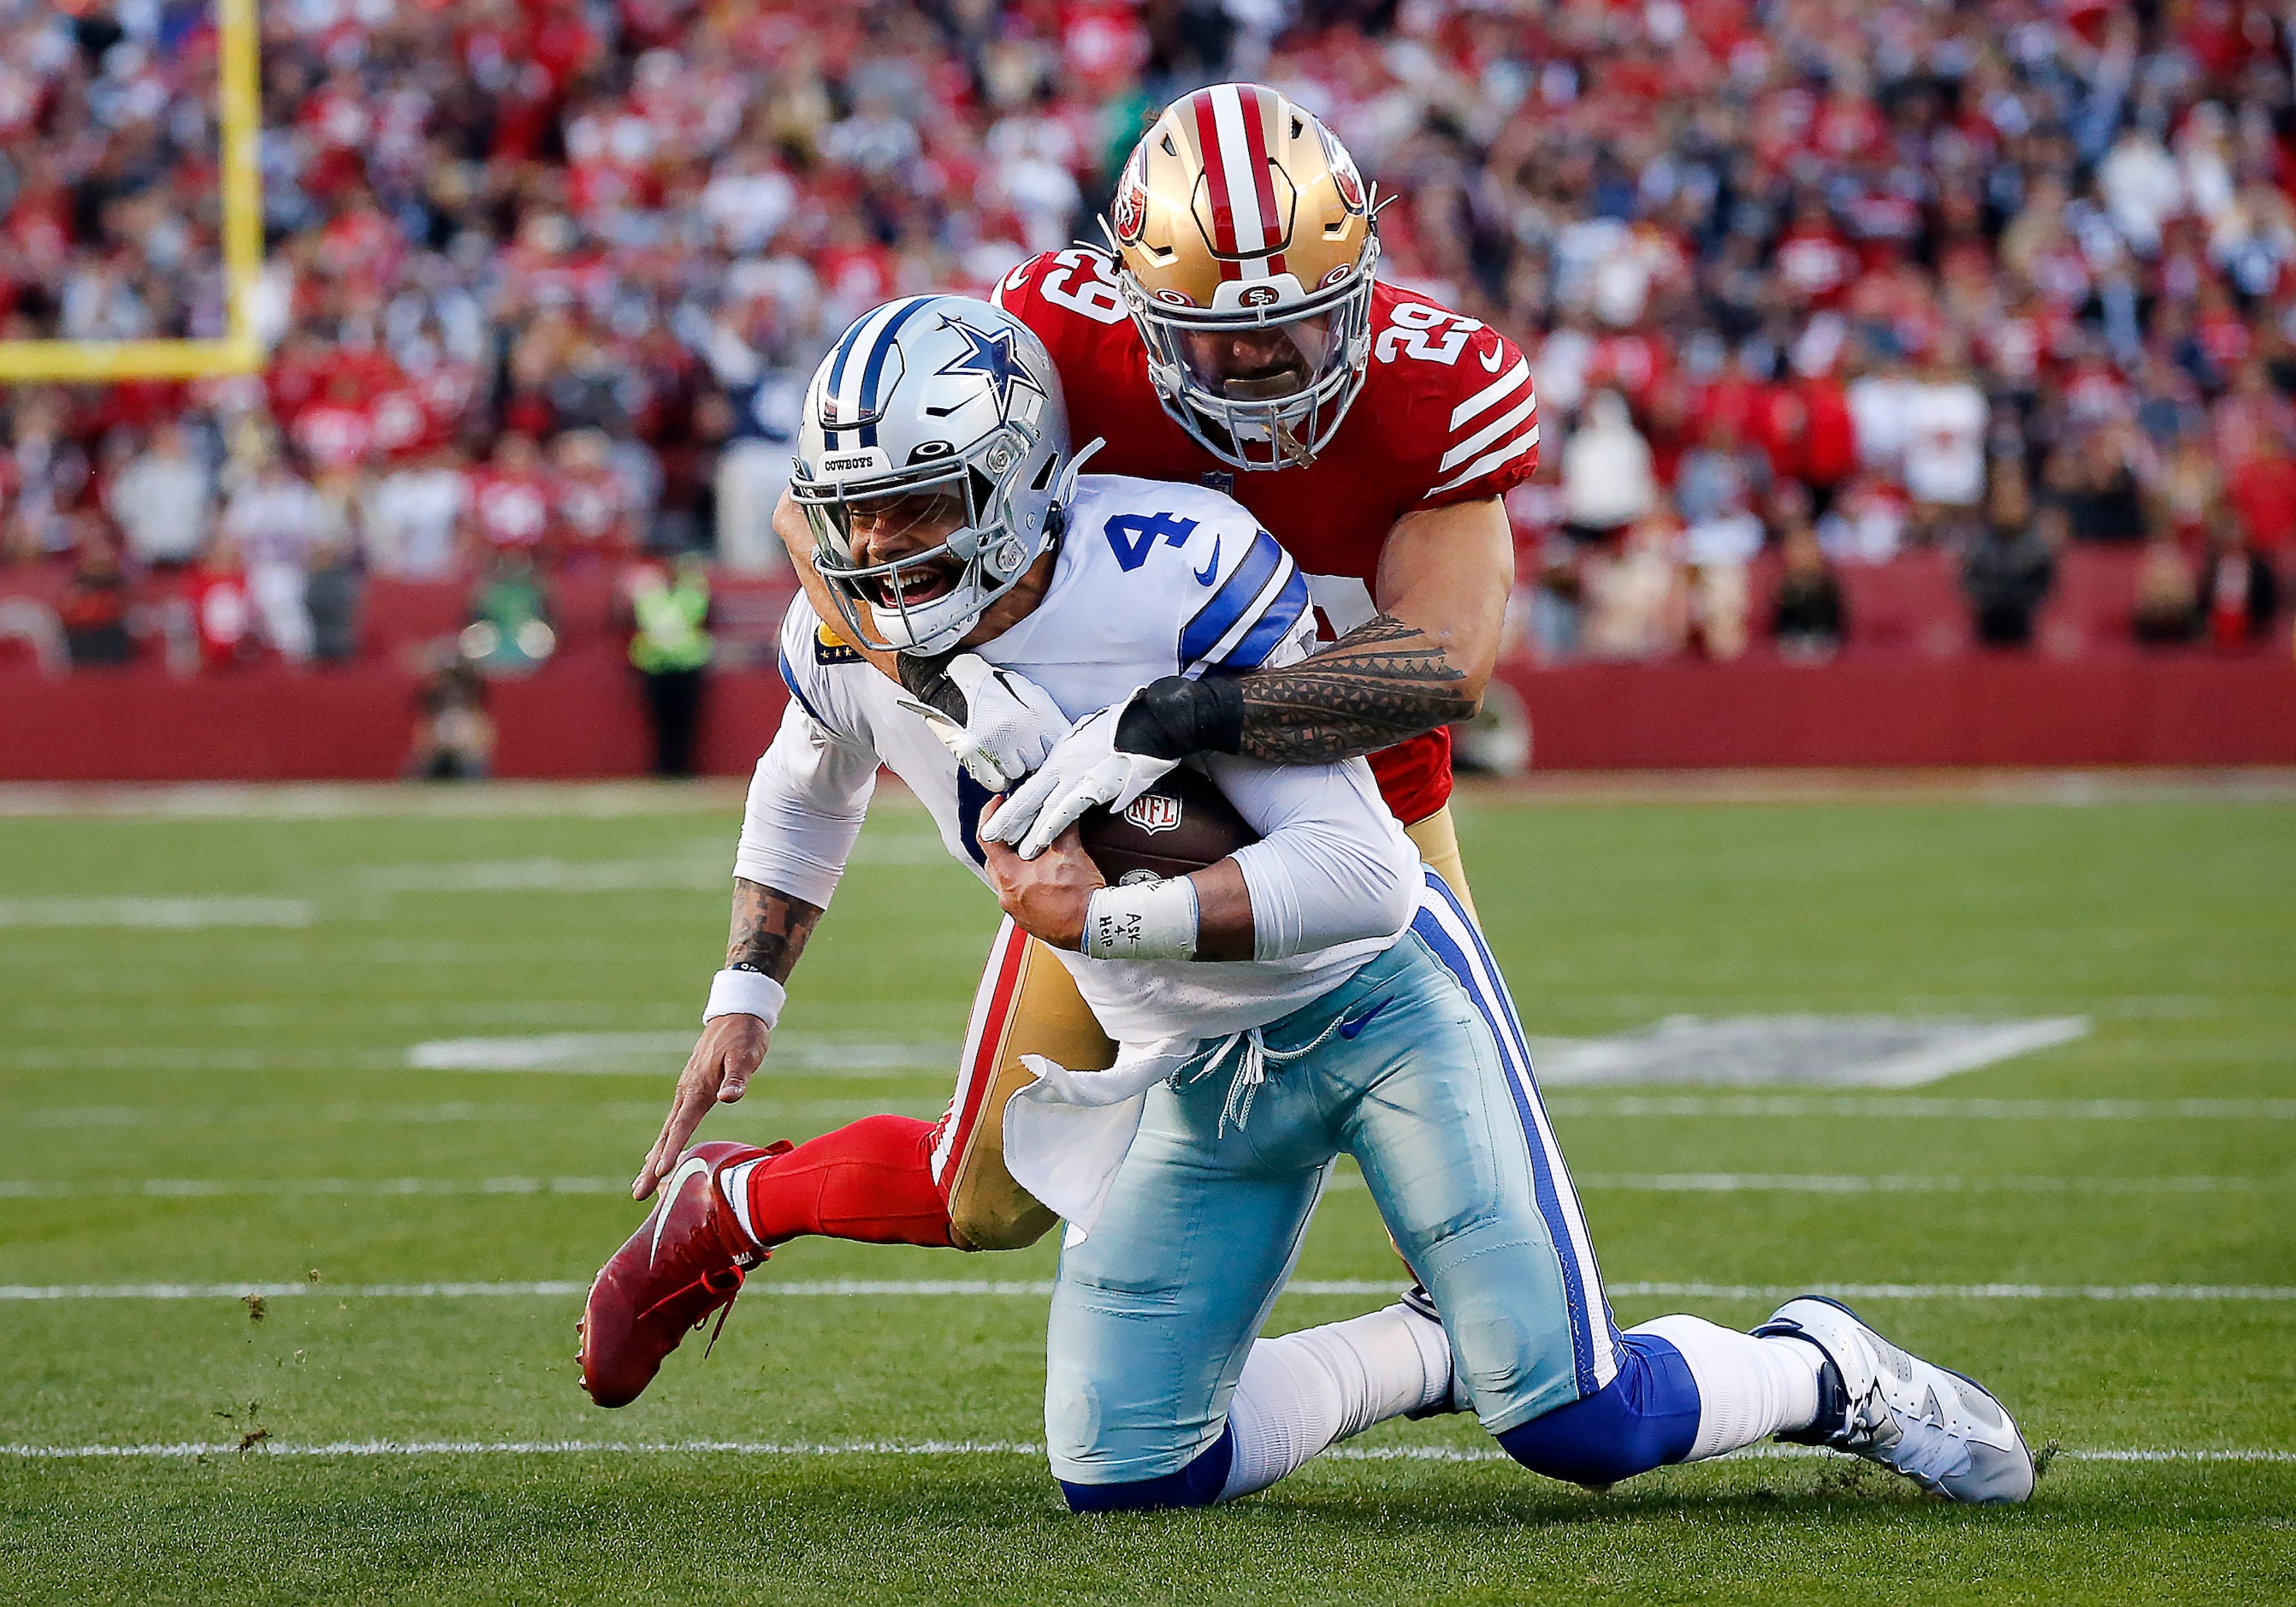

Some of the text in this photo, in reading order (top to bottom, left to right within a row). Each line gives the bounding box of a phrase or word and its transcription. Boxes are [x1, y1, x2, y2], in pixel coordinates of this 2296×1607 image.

[1040, 247, 1130, 325] 29
[1375, 302, 1485, 366] 29
[825, 456, 873, 471] COWBOYS
[1103, 512, 1201, 572] 4
[1131, 796, 1175, 824] NFL
[1114, 925, 1126, 936] 4
